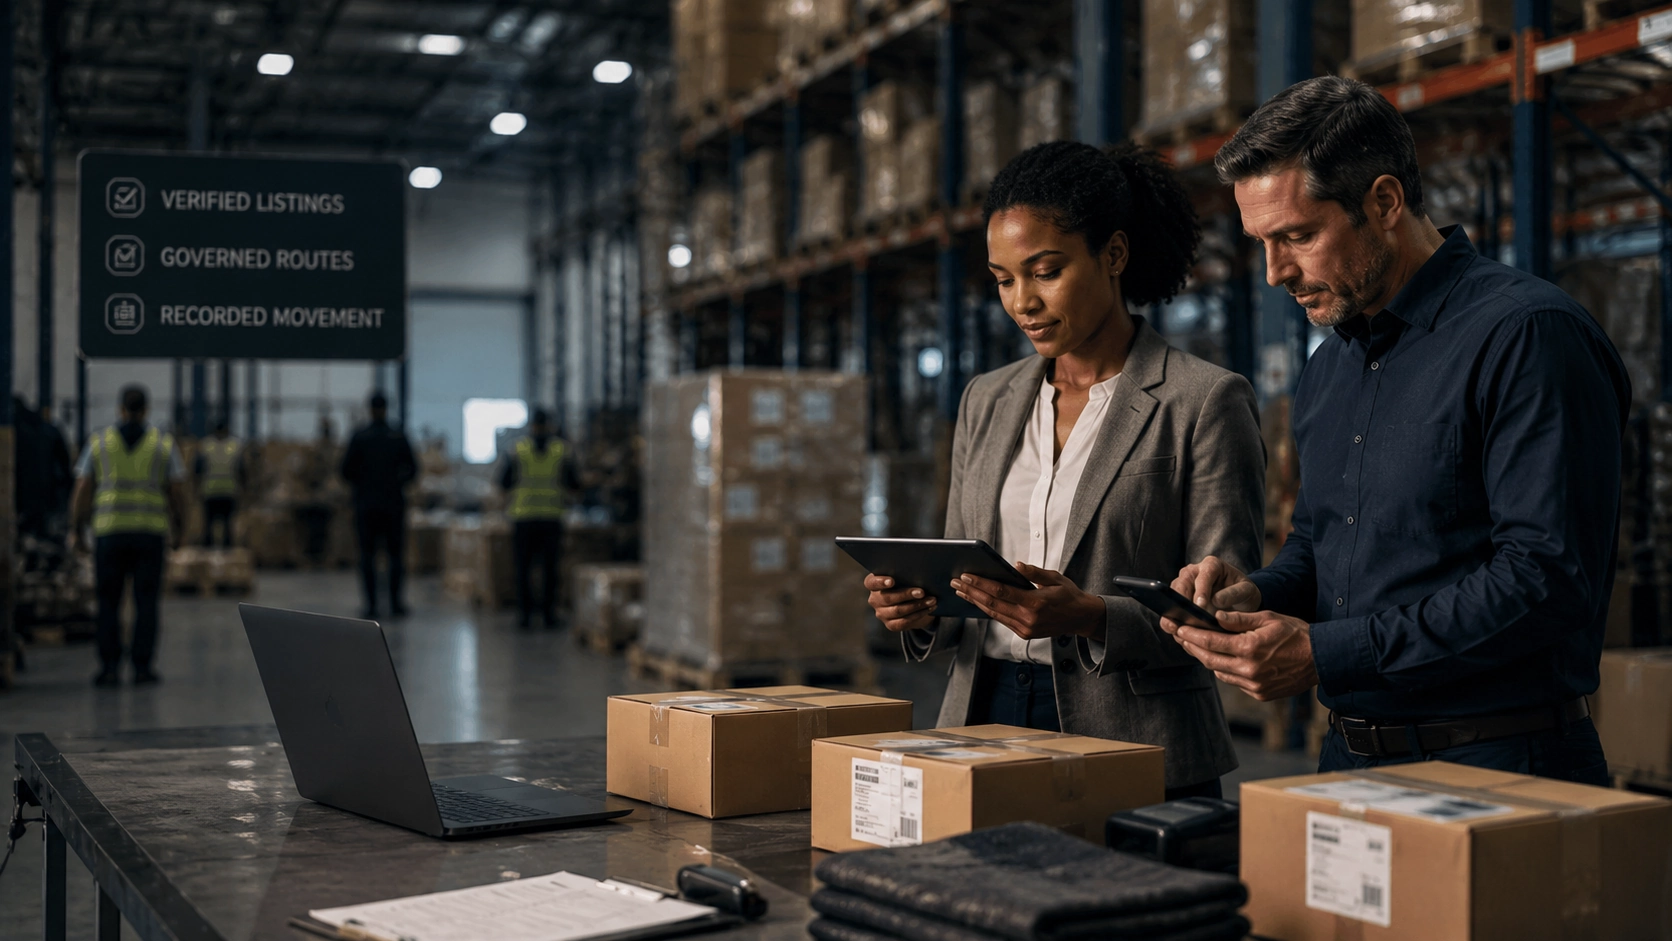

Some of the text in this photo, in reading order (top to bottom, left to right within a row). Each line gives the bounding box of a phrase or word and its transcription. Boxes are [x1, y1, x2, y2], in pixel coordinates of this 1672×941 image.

[161, 189, 345, 214] VERIFIED LISTINGS
[160, 246, 354, 271] GOVERNED ROUTES
[160, 305, 384, 328] RECORDED MOVEMENT
